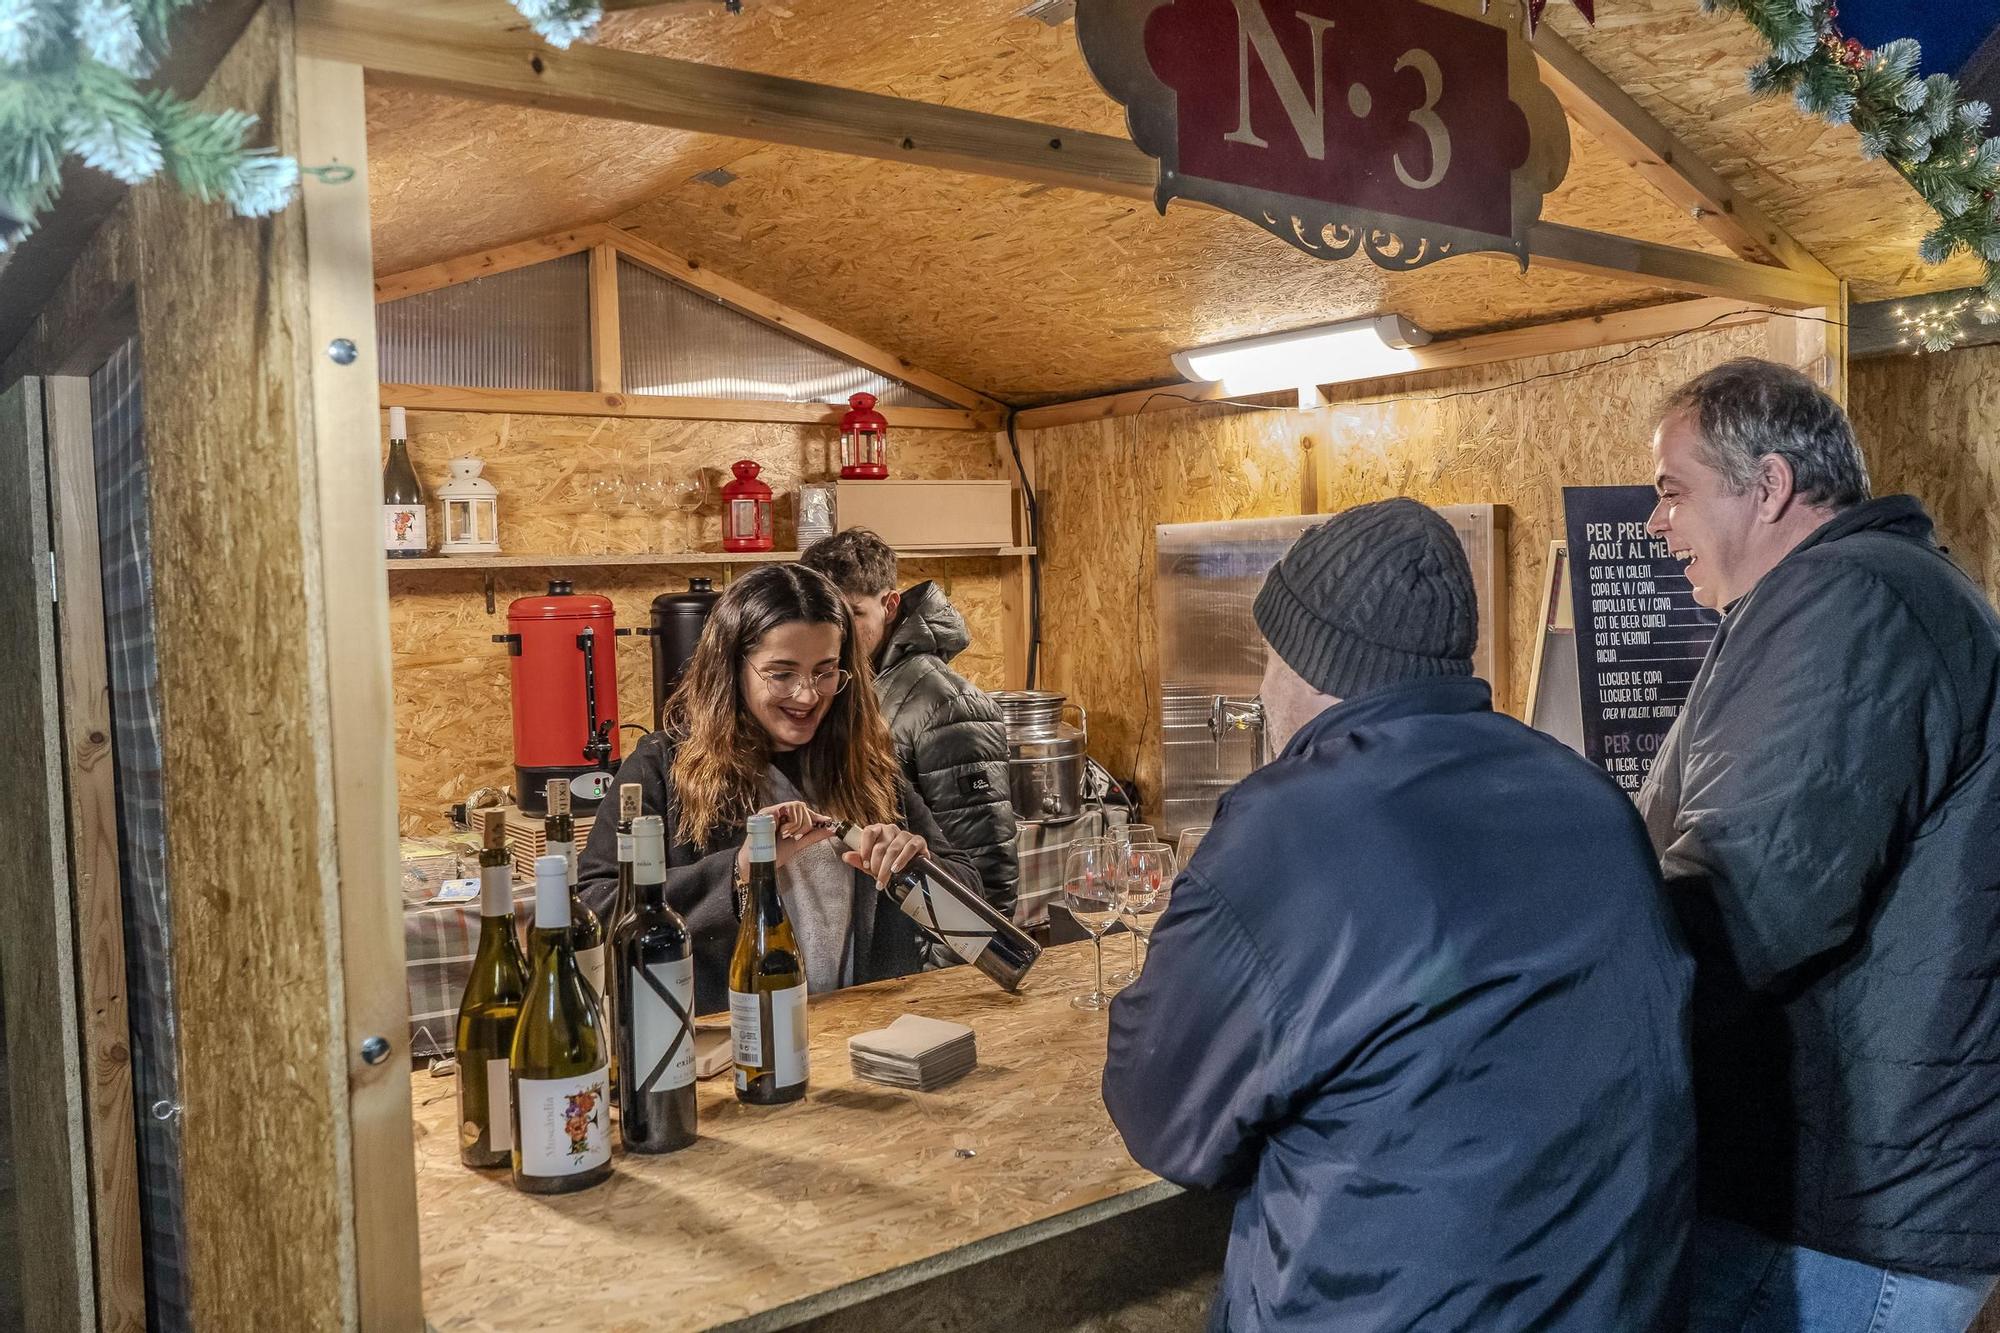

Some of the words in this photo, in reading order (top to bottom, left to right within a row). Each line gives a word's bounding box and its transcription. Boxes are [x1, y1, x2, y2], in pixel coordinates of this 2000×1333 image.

[1586, 523, 1612, 542] PER
[1618, 522, 1665, 541] PREN
[1588, 540, 1624, 560] AQUÍ
[1629, 542, 1646, 559] AL
[1590, 566, 1603, 580] GOT
[1605, 566, 1615, 579] DE
[1616, 566, 1624, 579] VI
[1626, 565, 1652, 578] CALENT
[1591, 583, 1610, 596] COPA
[1612, 582, 1621, 596] DE
[1622, 582, 1630, 595] VI
[1632, 582, 1635, 595] /
[1637, 582, 1655, 595] CAVA
[1592, 599, 1626, 612] AMPOLLA
[1627, 598, 1637, 612] DE
[1638, 598, 1646, 612] VI
[1648, 598, 1651, 611] /
[1653, 598, 1671, 611] CAVA
[1594, 616, 1608, 629] GOT
[1610, 616, 1619, 629] DE
[1621, 615, 1640, 628] BEER
[1596, 633, 1608, 646] GOT
[1611, 632, 1621, 646] DE
[1621, 632, 1651, 645] VERMUT
[1596, 649, 1617, 662] AIGUA
[1598, 672, 1630, 686] LLOGUER
[1632, 672, 1641, 685] DE
[1644, 671, 1662, 684] COPA
[1600, 689, 1631, 702] LLOGUER
[1633, 688, 1642, 702] DE
[1645, 688, 1658, 701] GOT
[1603, 708, 1618, 720] (PER
[1620, 707, 1626, 719] VI
[1604, 735, 1630, 753] PER
[1605, 759, 1613, 772] VI
[1616, 758, 1639, 771] NEGRE
